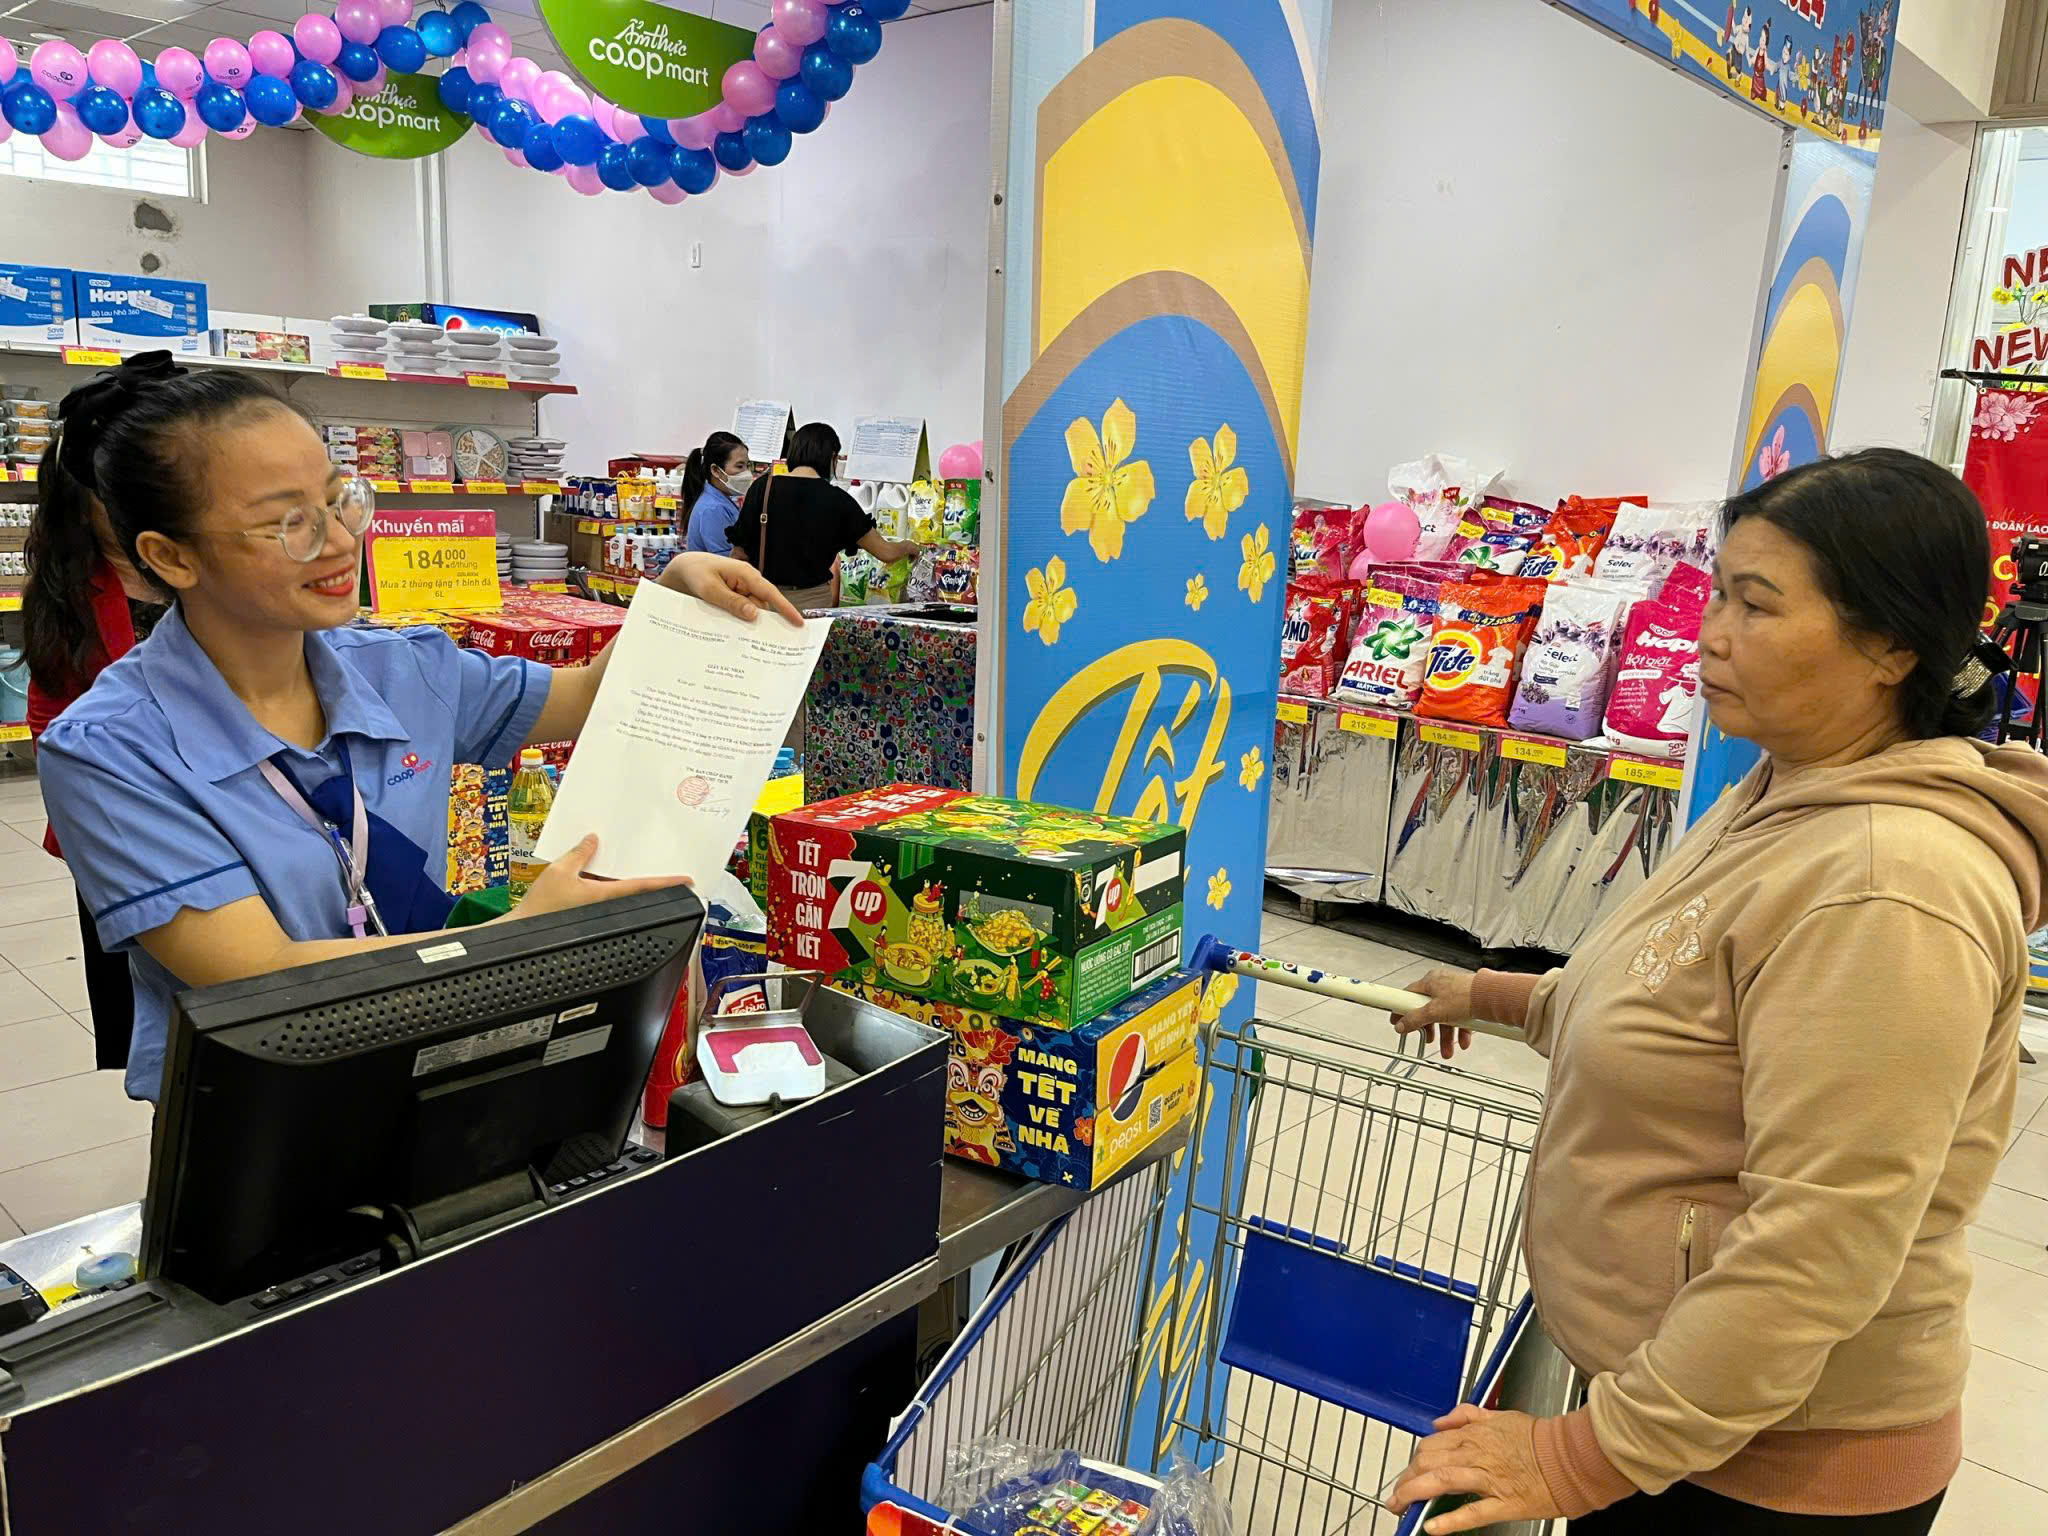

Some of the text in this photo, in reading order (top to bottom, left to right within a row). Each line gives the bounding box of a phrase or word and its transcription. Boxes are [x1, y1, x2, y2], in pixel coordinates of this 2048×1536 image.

[666, 64, 709, 87] mart
[398, 115, 441, 133] mart
[372, 516, 465, 536] Khuyến mãi
[402, 580, 407, 588] 2
[1344, 660, 1409, 690] ARIEL
[1425, 645, 1476, 680] Tide
[511, 848, 533, 857] Selec
[797, 838, 821, 867] TẾT
[790, 871, 827, 900] TRÒN
[796, 931, 821, 960] KẾT
[1018, 1047, 1077, 1075] MANG
[1017, 1070, 1077, 1105] TẾT
[1028, 1104, 1063, 1128] VỀ
[1018, 1124, 1070, 1155] NHÀ
[1109, 1118, 1143, 1160] pepsi
